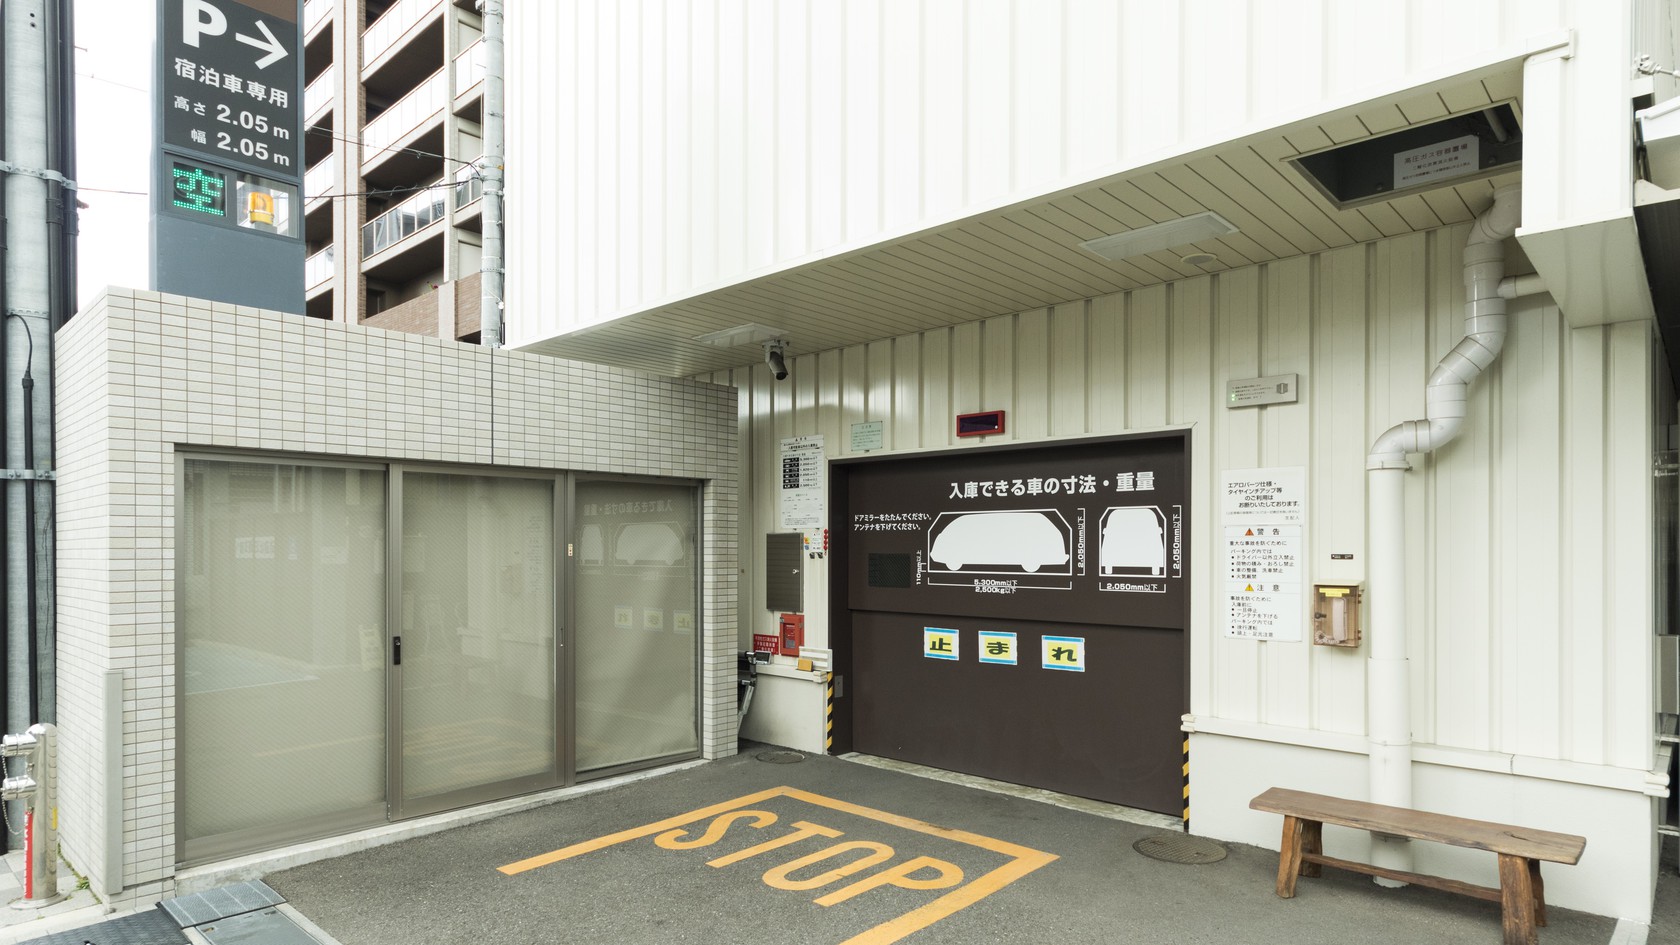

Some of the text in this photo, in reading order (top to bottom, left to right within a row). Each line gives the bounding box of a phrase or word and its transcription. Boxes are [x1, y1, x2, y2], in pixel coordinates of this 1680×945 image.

[182, 0, 228, 49] P
[174, 57, 289, 109] 宿泊車専用
[174, 95, 290, 141] 高さ 2.05 m
[191, 128, 290, 167] 幅 2.05 m
[173, 167, 224, 217] 空
[949, 471, 1155, 500] 入庫できる車の寸法・重量
[1228, 487, 1282, 495] タイヤインチアップ等
[854, 513, 932, 522] ドアミラーをたたんでください。
[854, 522, 921, 531] アンテナを下げてください。
[929, 637, 1077, 663] 止 ま れ
[653, 809, 965, 908] STOP
